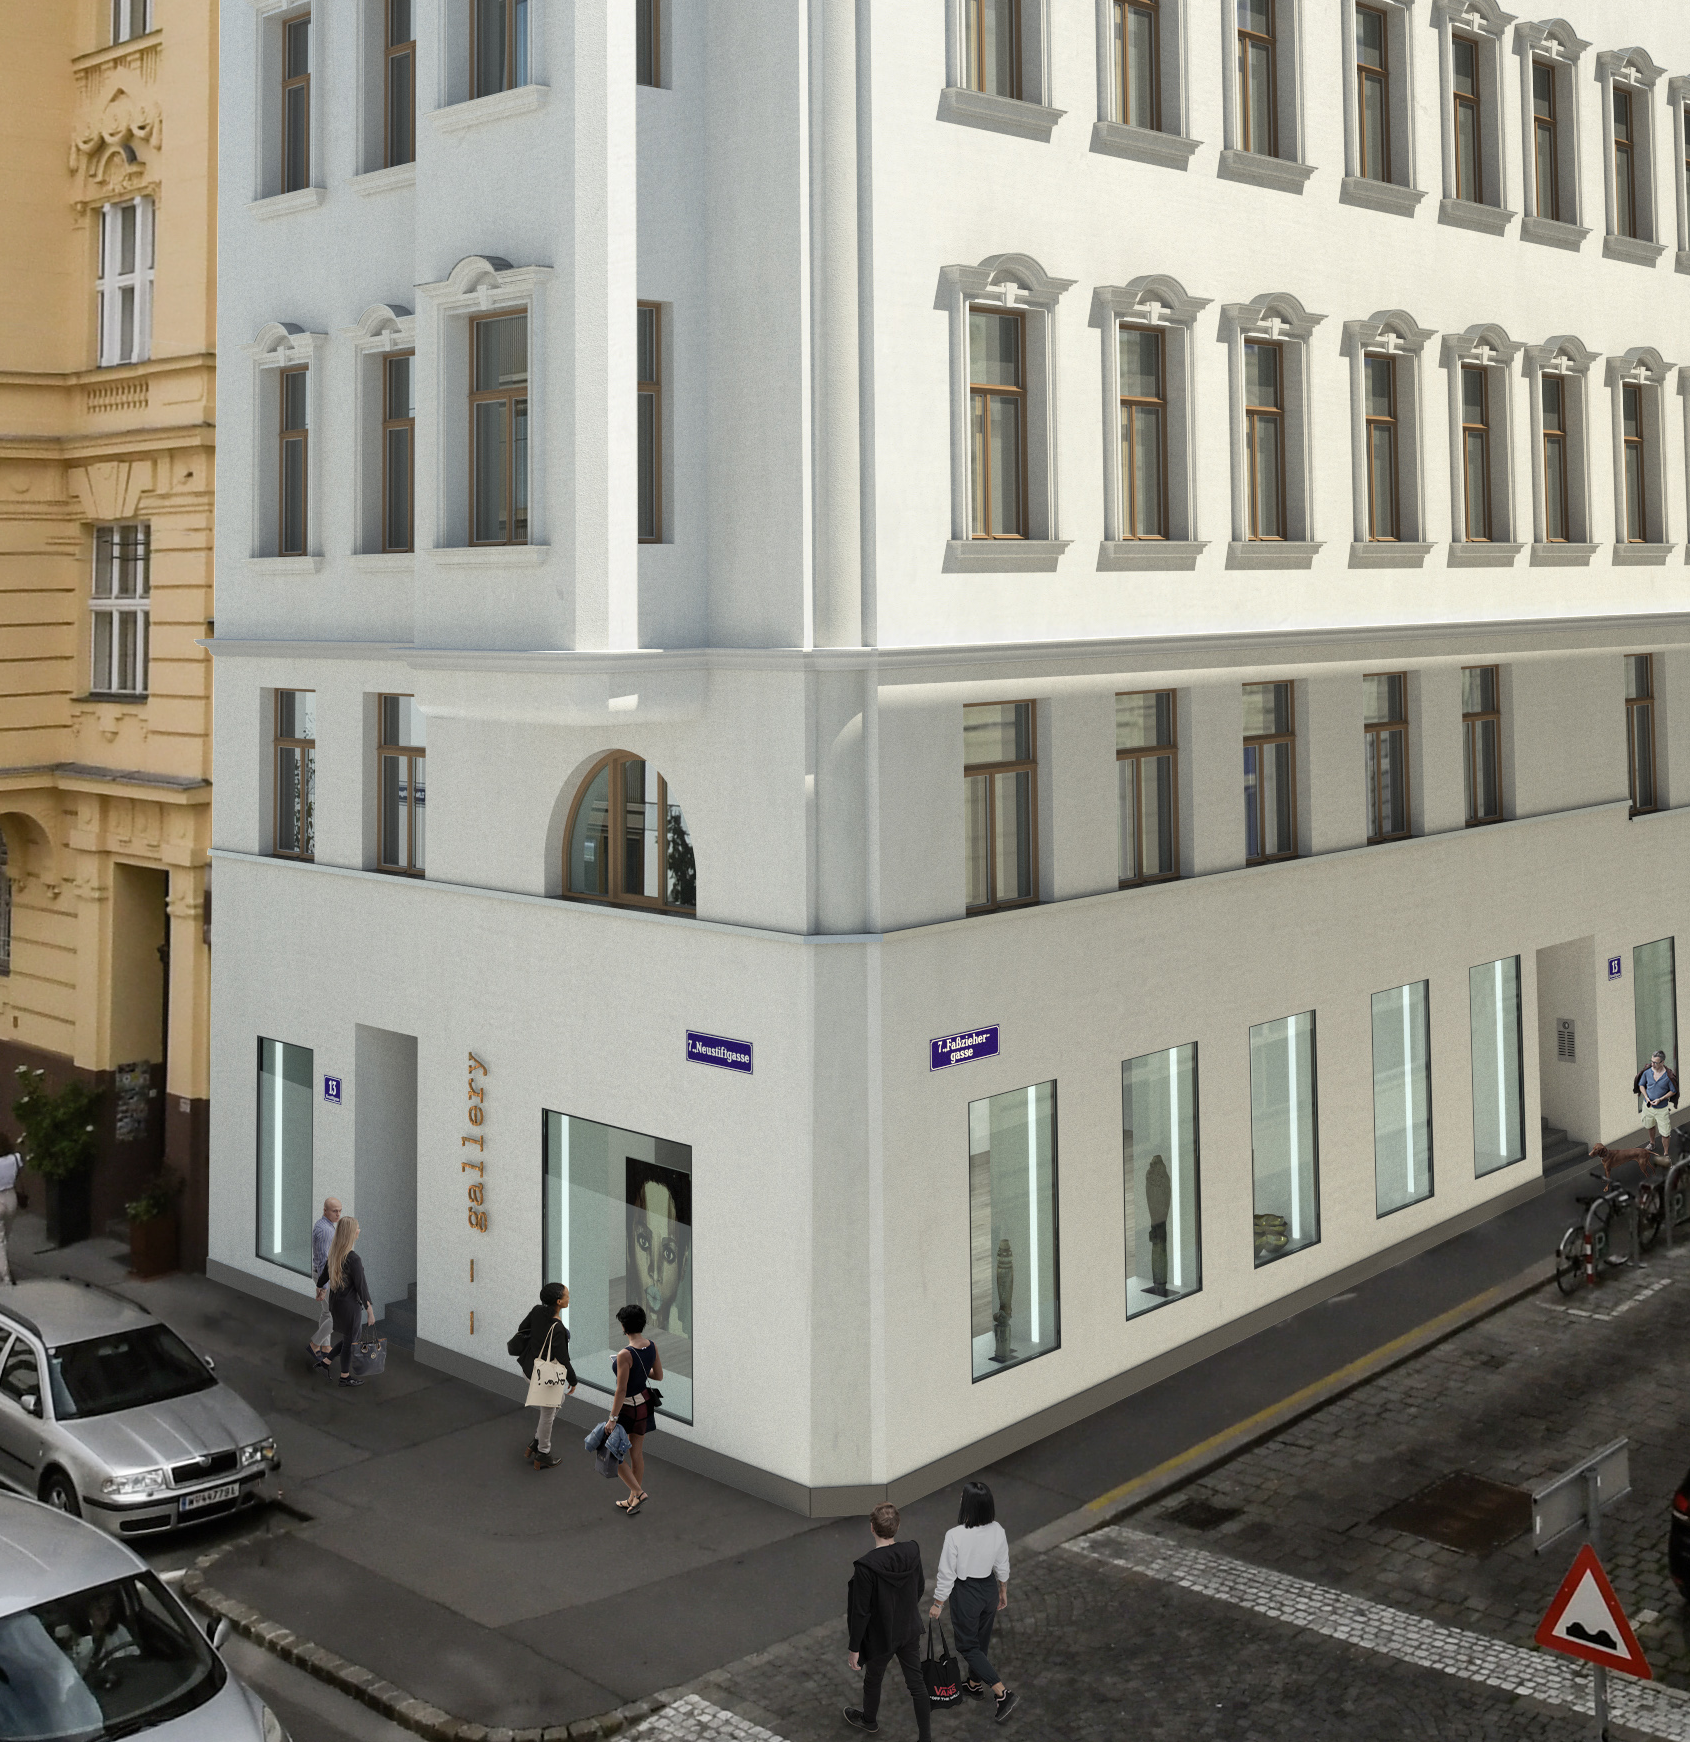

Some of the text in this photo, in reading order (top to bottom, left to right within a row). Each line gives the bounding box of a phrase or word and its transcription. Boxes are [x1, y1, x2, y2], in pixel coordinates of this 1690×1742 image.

[950, 1047, 974, 1064] gasse
[328, 1079, 337, 1095] 13
[461, 1051, 488, 1234] gallery
